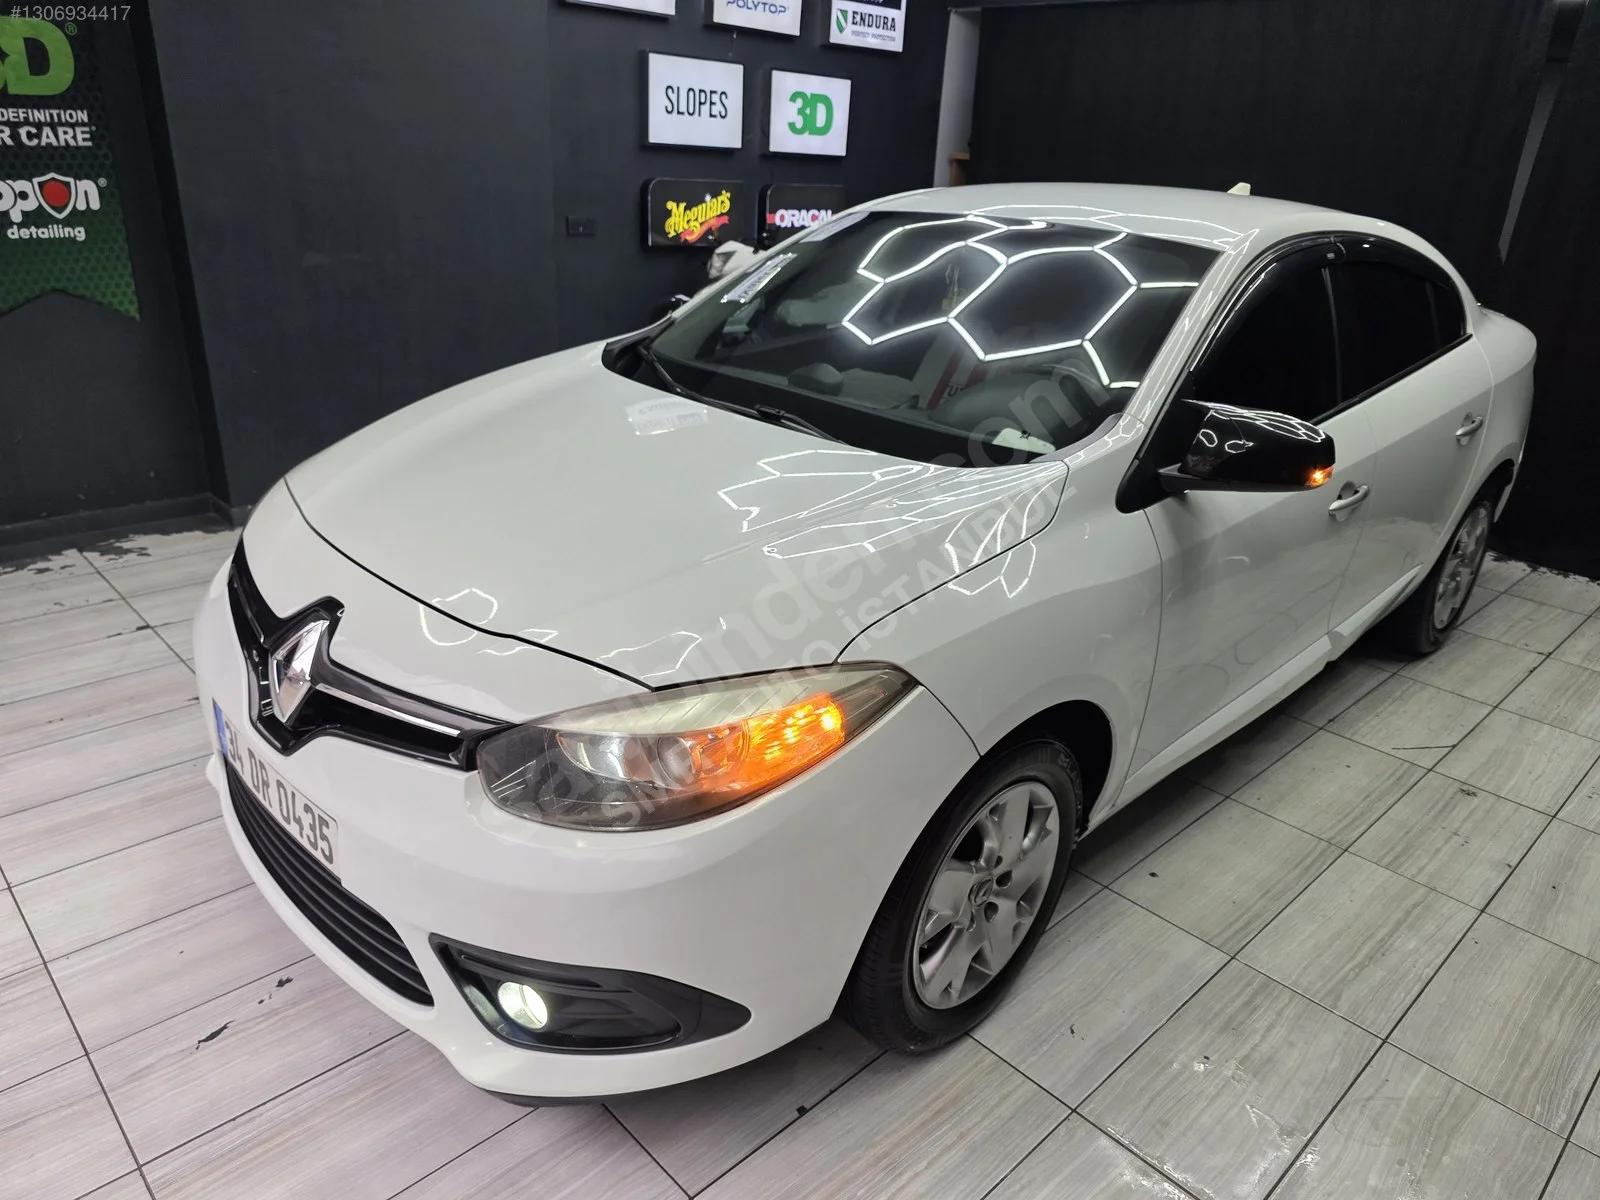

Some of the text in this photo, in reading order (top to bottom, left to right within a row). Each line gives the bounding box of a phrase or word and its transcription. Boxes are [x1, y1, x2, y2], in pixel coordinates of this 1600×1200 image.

[851, 10, 897, 32] ENDURA
[664, 84, 729, 120] SLOPES
[787, 90, 835, 137] 3D
[0, 107, 89, 124] DEFINITION
[18, 125, 94, 148] CARE
[6, 223, 87, 242] detailing
[224, 719, 334, 865] 34 DR 0435
